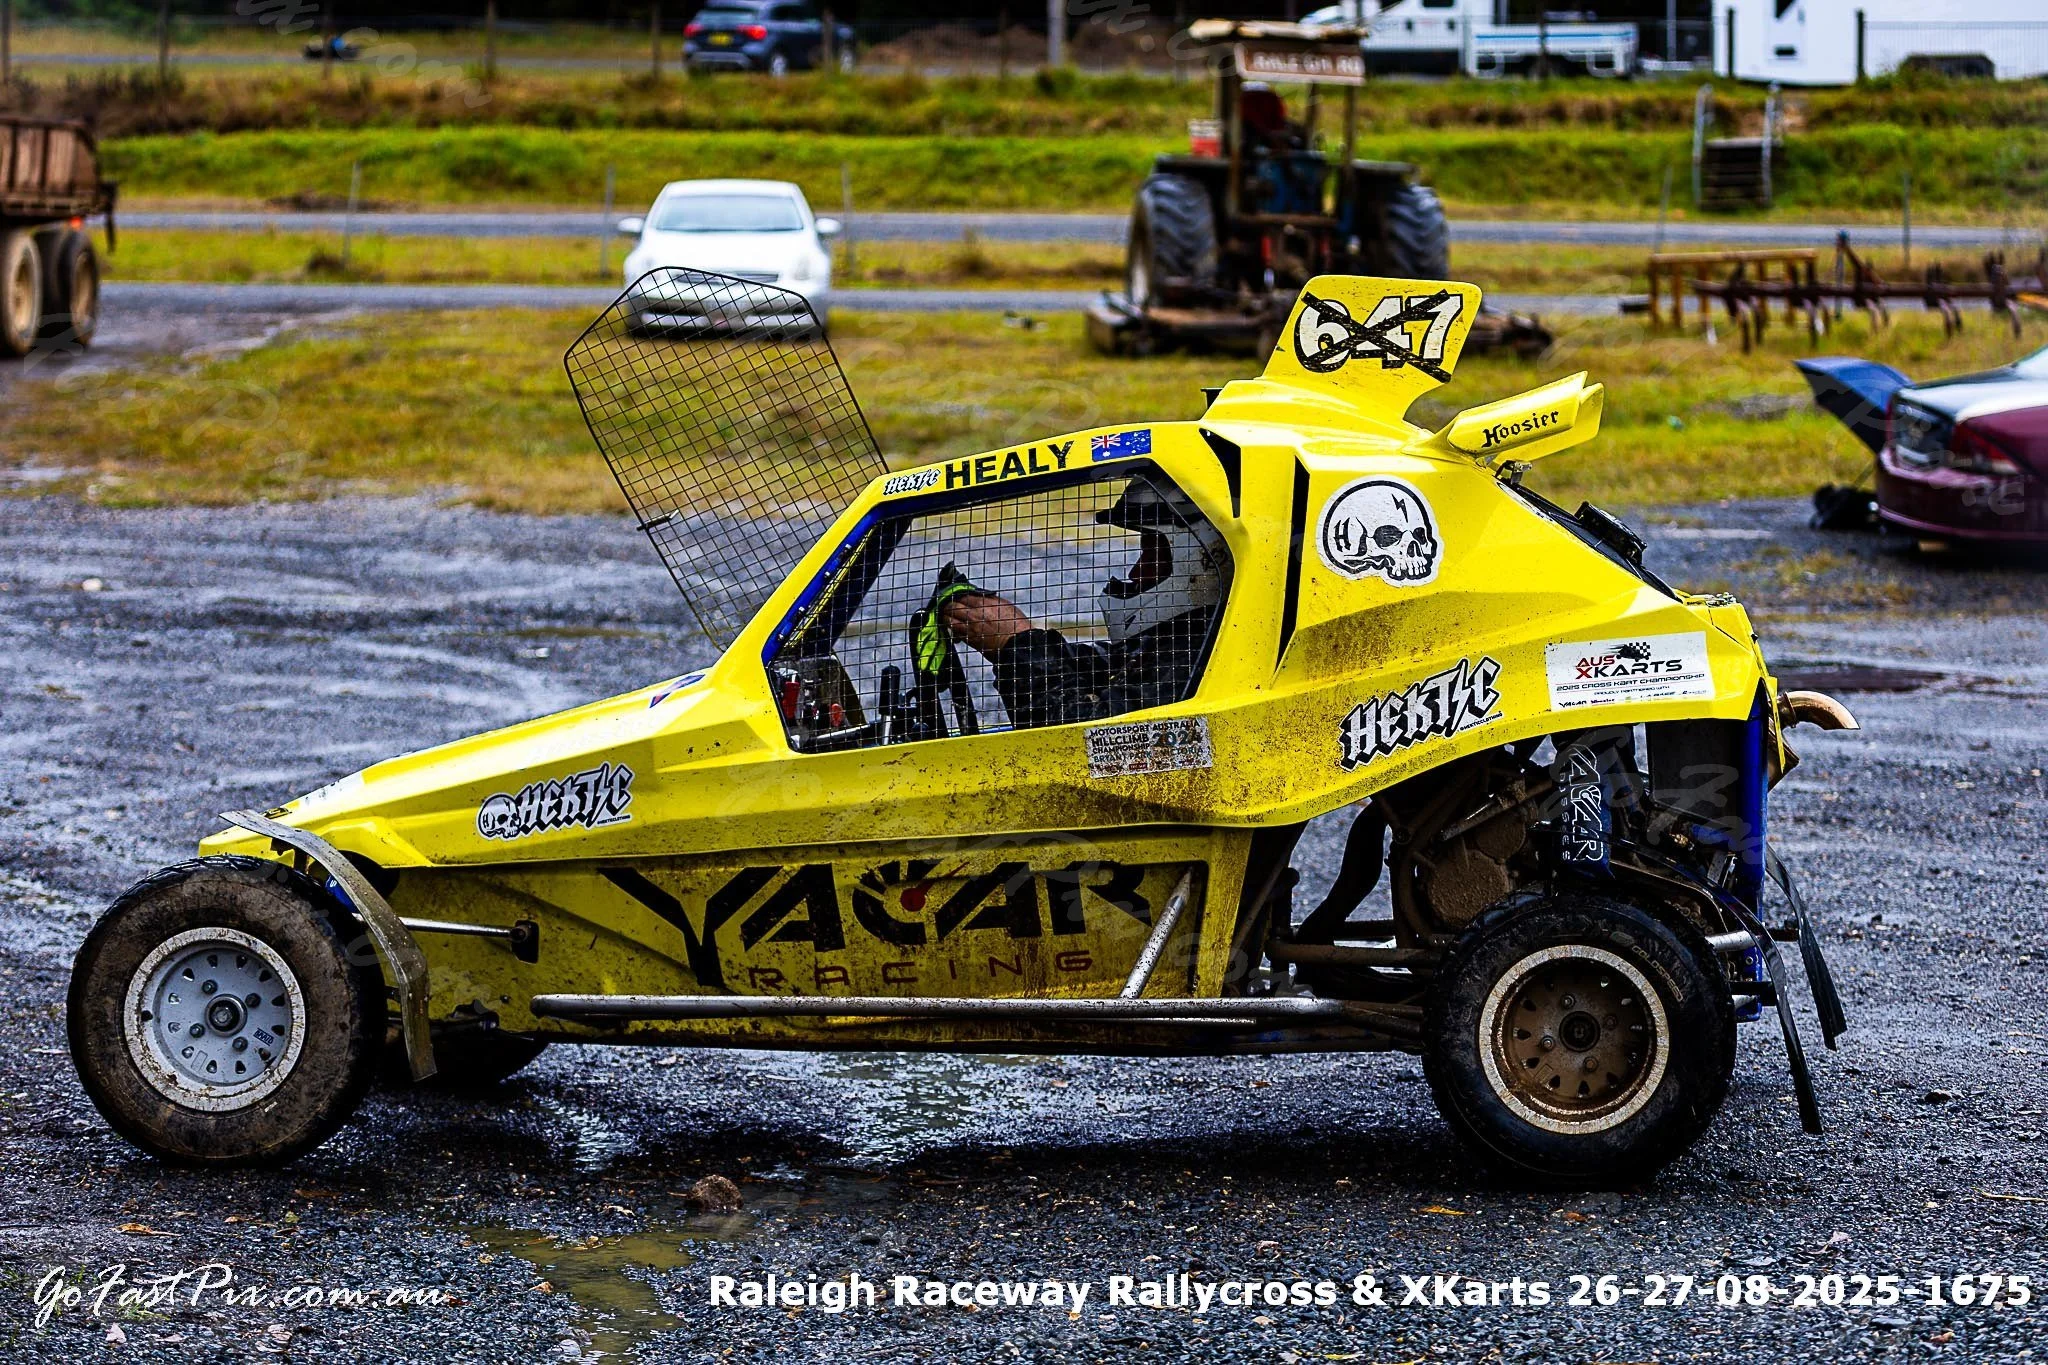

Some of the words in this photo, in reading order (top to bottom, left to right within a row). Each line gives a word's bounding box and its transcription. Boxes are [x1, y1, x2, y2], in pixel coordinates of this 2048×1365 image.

[1294, 293, 1463, 373] 647
[1481, 408, 1560, 448] Hoosier
[945, 441, 1074, 490] HEALY
[1575, 659, 1683, 680] XKARTS
[1576, 655, 1616, 667] AUS
[1556, 684, 1580, 692] 2025
[1090, 725, 1149, 737] MOTORSPORT
[1153, 720, 1200, 731] AUSTRALIA
[1092, 733, 1149, 747] HILLCLIMB
[1092, 743, 1151, 755] CHAMPIONSHIP
[599, 860, 1153, 988] YACAR
[749, 949, 1094, 992] RACING
